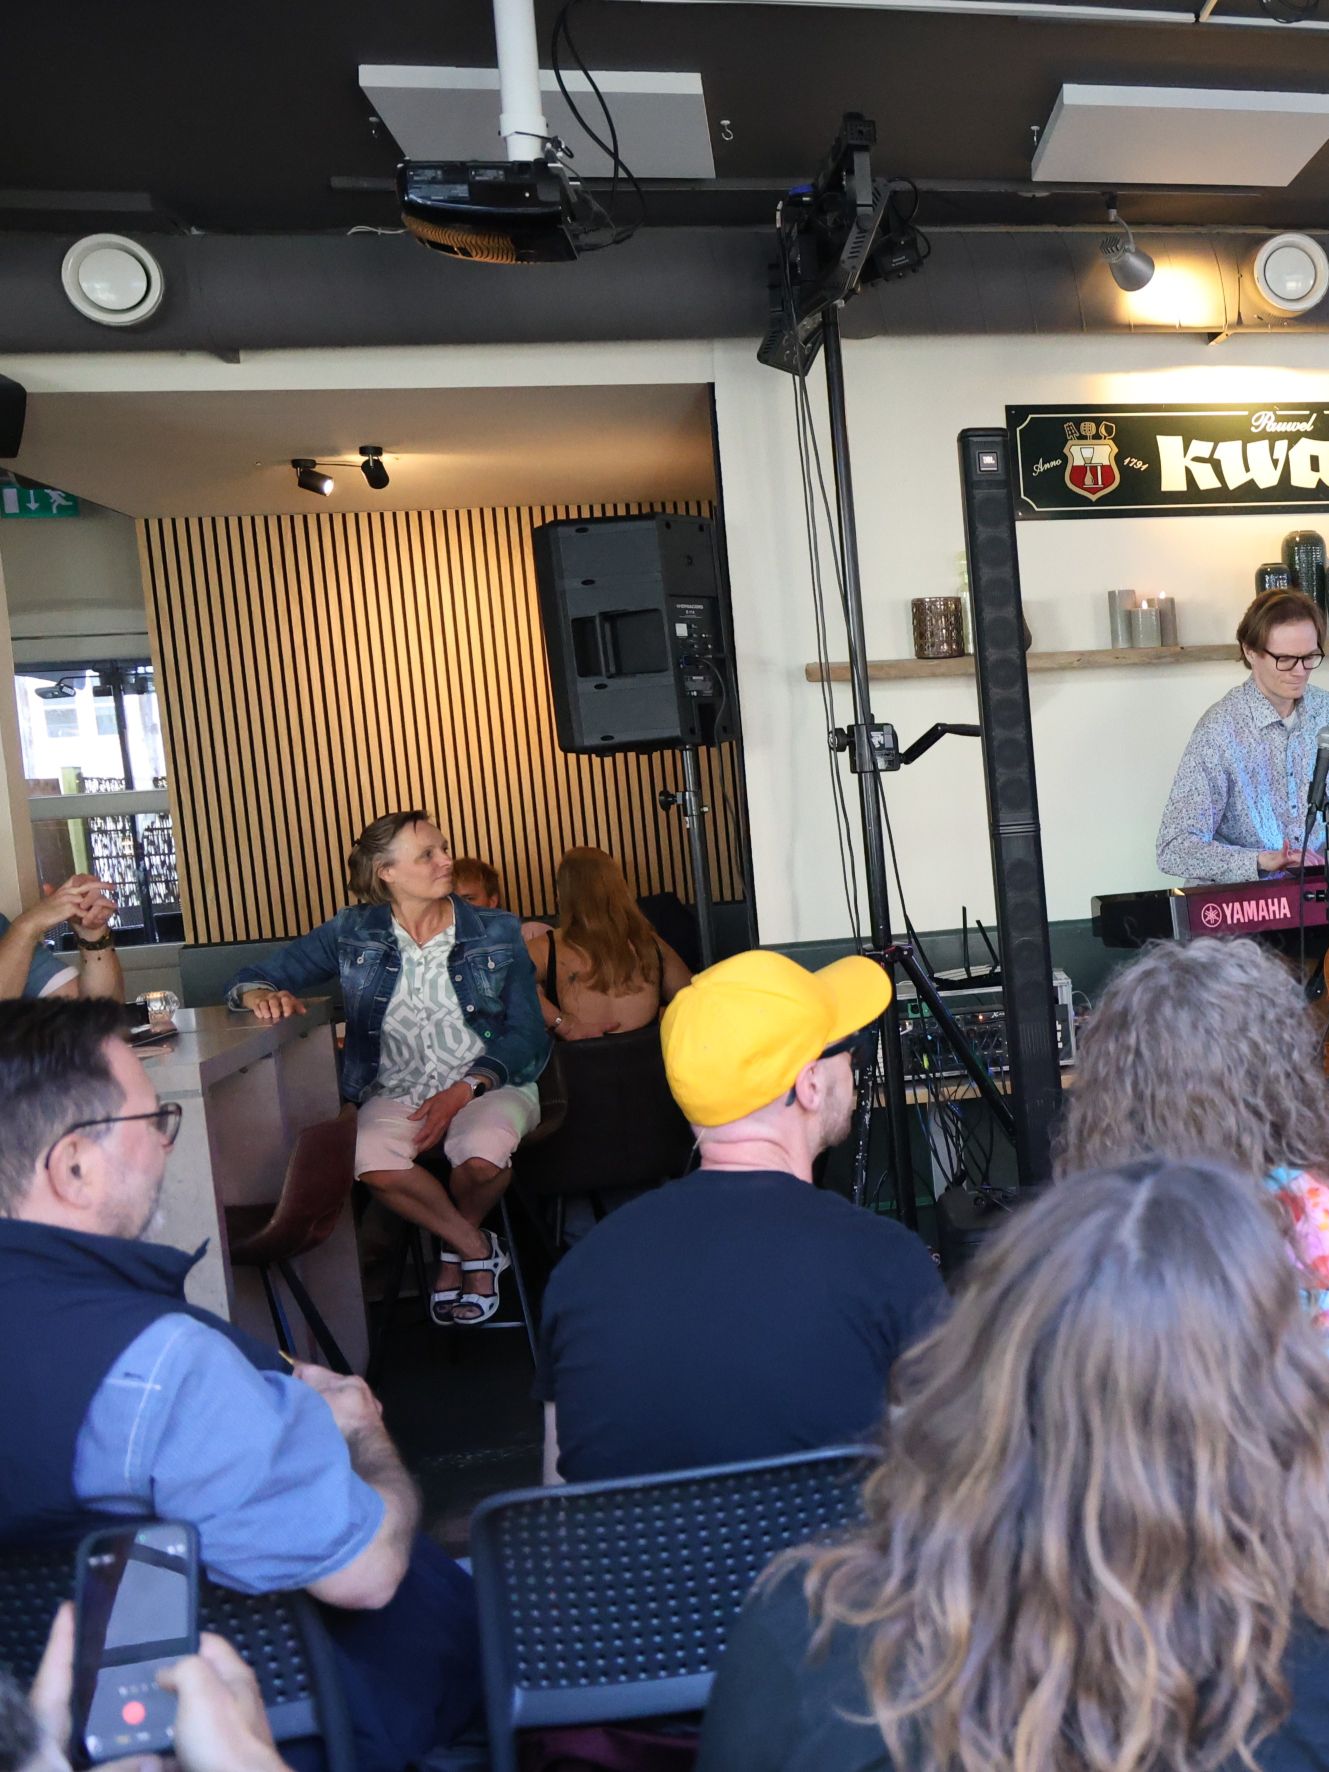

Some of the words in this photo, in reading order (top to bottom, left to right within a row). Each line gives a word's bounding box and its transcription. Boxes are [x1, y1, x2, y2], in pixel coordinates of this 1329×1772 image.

[1250, 411, 1317, 433] Pauwel
[1032, 458, 1063, 477] Anno
[1123, 456, 1149, 471] 1791
[1222, 897, 1291, 925] YAMAHA
